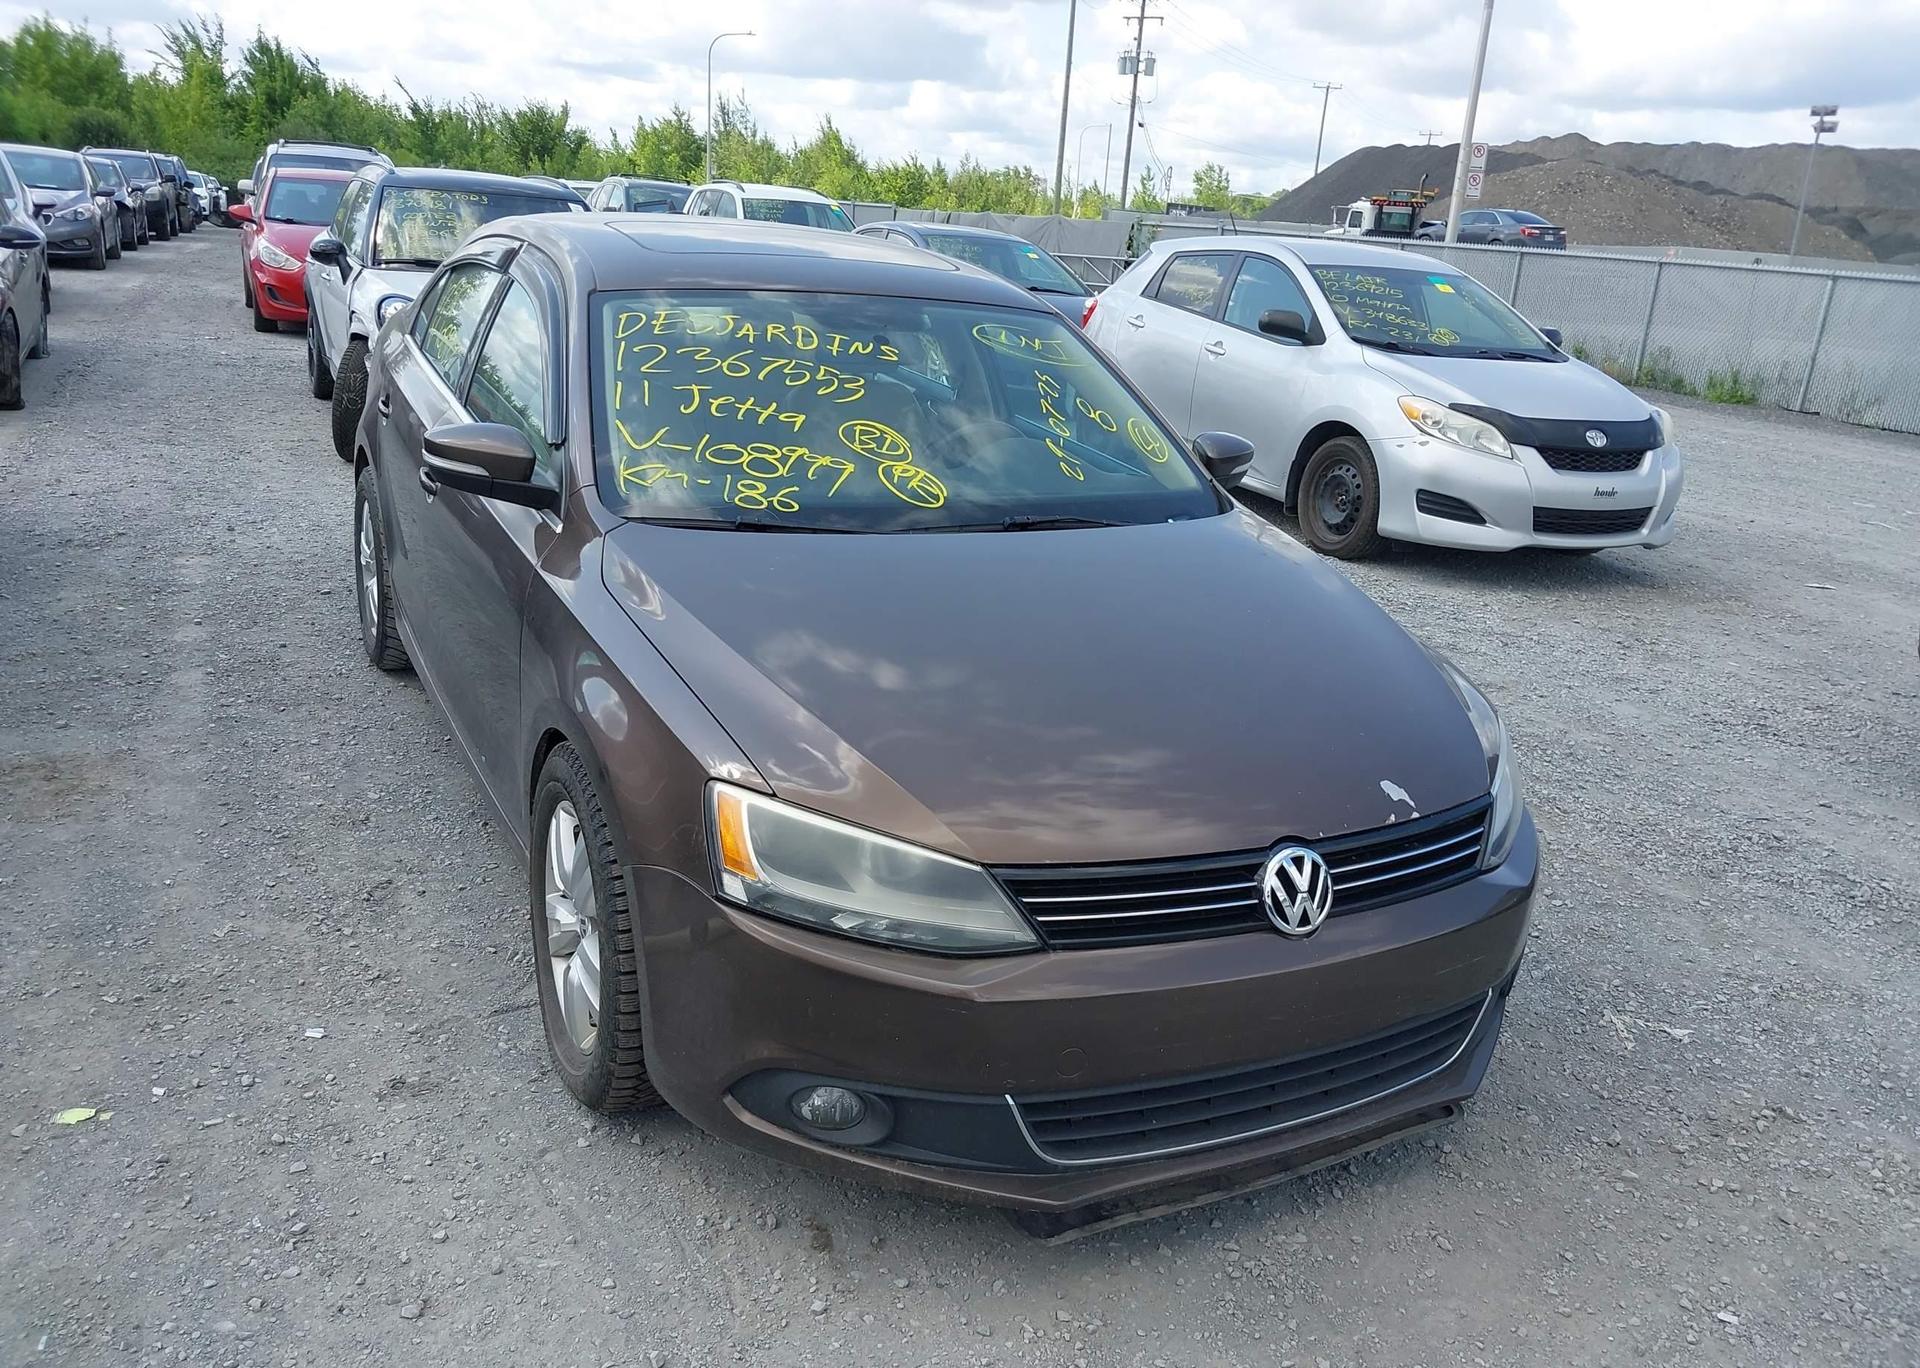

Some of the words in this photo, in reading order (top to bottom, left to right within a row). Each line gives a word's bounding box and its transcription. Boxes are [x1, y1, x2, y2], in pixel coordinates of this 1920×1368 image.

[614, 310, 900, 362] DESJARDINS
[616, 340, 866, 404] 12367553
[615, 379, 649, 410] 11
[672, 383, 808, 432] Jetta
[1263, 846, 1333, 935] VW
